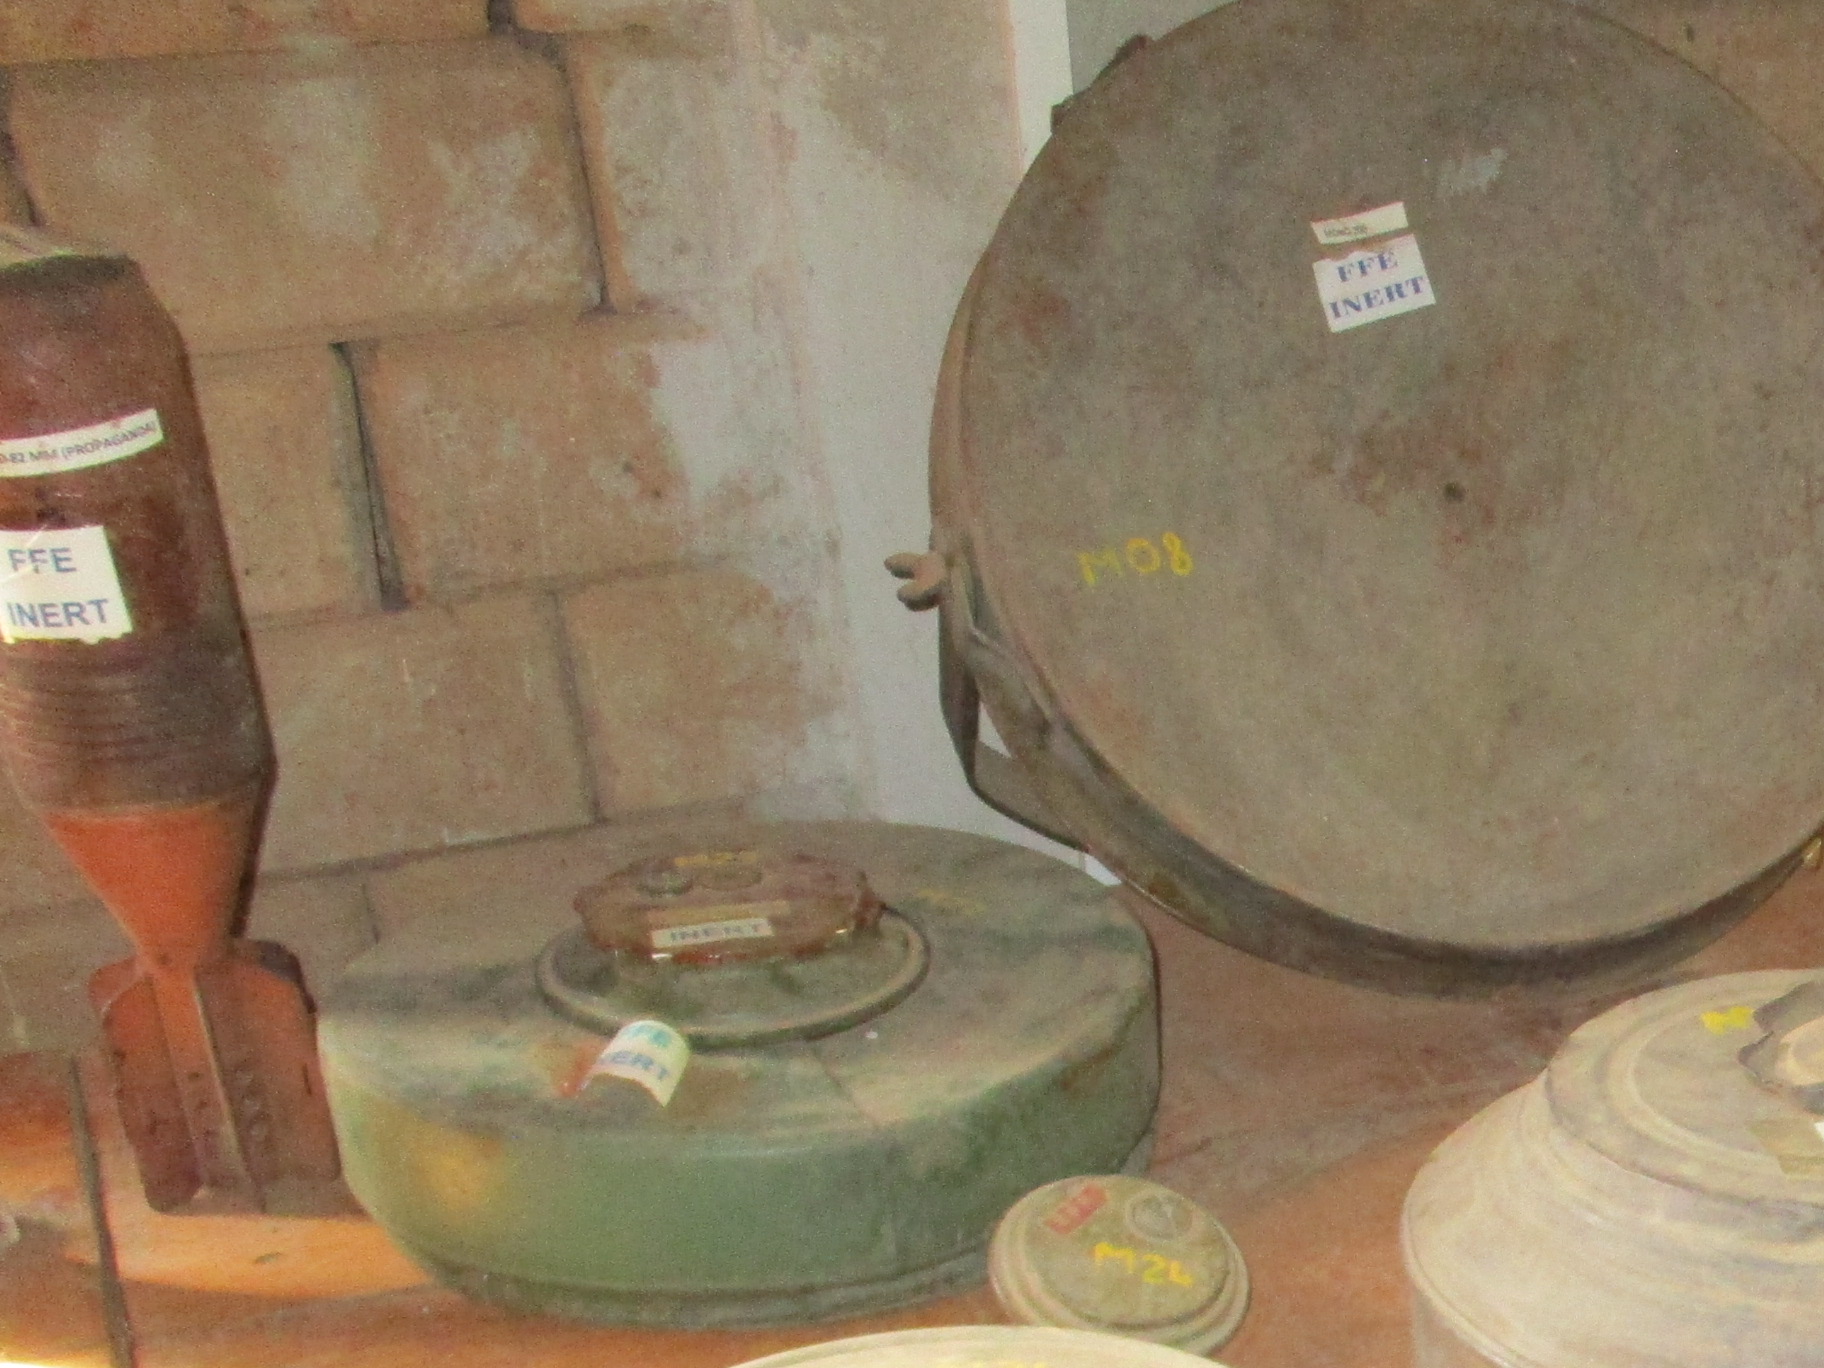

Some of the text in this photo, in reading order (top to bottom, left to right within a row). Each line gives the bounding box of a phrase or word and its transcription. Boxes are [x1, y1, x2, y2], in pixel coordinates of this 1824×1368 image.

[1337, 248, 1399, 282] FFE
[1329, 276, 1424, 319] INERT
[8, 547, 77, 574] FFE
[1080, 531, 1194, 585] M08
[6, 598, 109, 627] INERT
